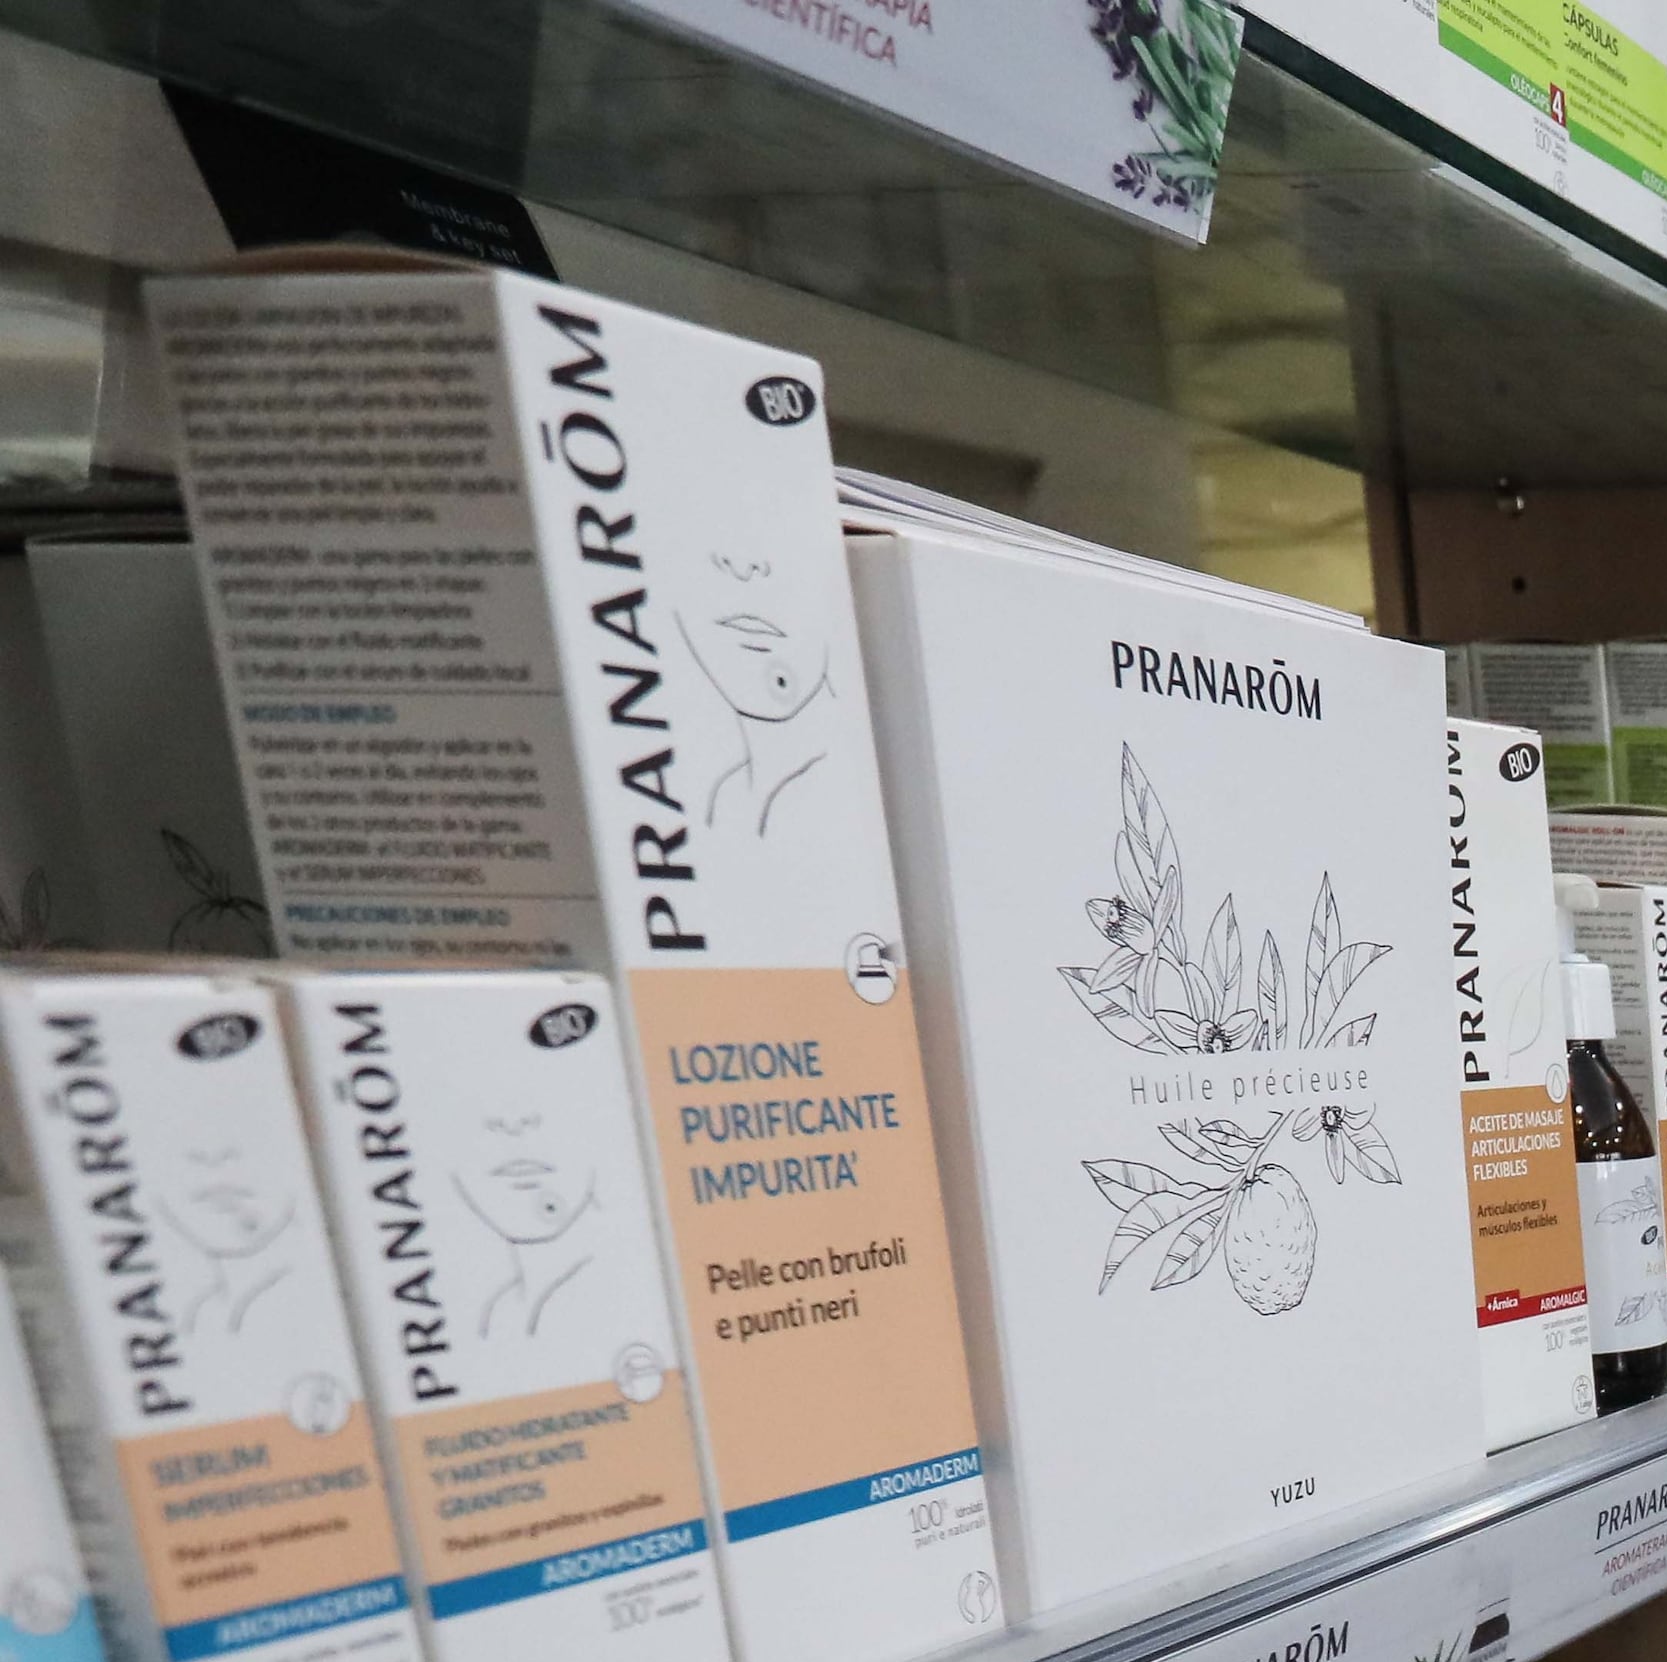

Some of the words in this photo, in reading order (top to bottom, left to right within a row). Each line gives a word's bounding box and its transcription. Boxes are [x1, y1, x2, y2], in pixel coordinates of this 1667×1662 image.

[1551, 91, 1564, 124] 4
[762, 381, 801, 422] BIO
[538, 305, 706, 953] PRANARŌM
[1111, 640, 1322, 721] PRANARŌM
[1508, 748, 1531, 779] BIO
[669, 1040, 823, 1085] LOZIONE
[1129, 1071, 1213, 1105] Huile
[1233, 1065, 1369, 1104] précieuse
[680, 1094, 899, 1145] PURIFICANTE
[1469, 1113, 1507, 1134] ACEITE
[1508, 1113, 1526, 1131] DE
[1525, 1108, 1565, 1129] MASAJE
[1471, 1131, 1561, 1158] ARTICULACIONES
[691, 1151, 859, 1204] IMPURITA'
[1473, 1159, 1529, 1182] FLEXIBLES
[44, 1014, 194, 1418] PRANARŌM
[333, 1001, 459, 1401] PRANARŌM
[1477, 1199, 1540, 1219] Articulaciones
[1541, 1198, 1548, 1214] y
[1478, 1216, 1522, 1238] músculos
[1522, 1214, 1559, 1232] flexibles
[706, 1256, 774, 1295] Pelle
[779, 1252, 825, 1284] con
[828, 1238, 907, 1276] brufoli
[715, 1314, 732, 1341] e
[739, 1299, 804, 1343] punti
[809, 1290, 859, 1324] neri
[1540, 1289, 1586, 1314] AROMALGIC
[869, 1453, 978, 1503] AROMADERM
[1271, 1477, 1316, 1507] YUZU
[541, 1527, 693, 1588] AROMADERM
[1611, 1557, 1667, 1597] CIENTÍFICA
